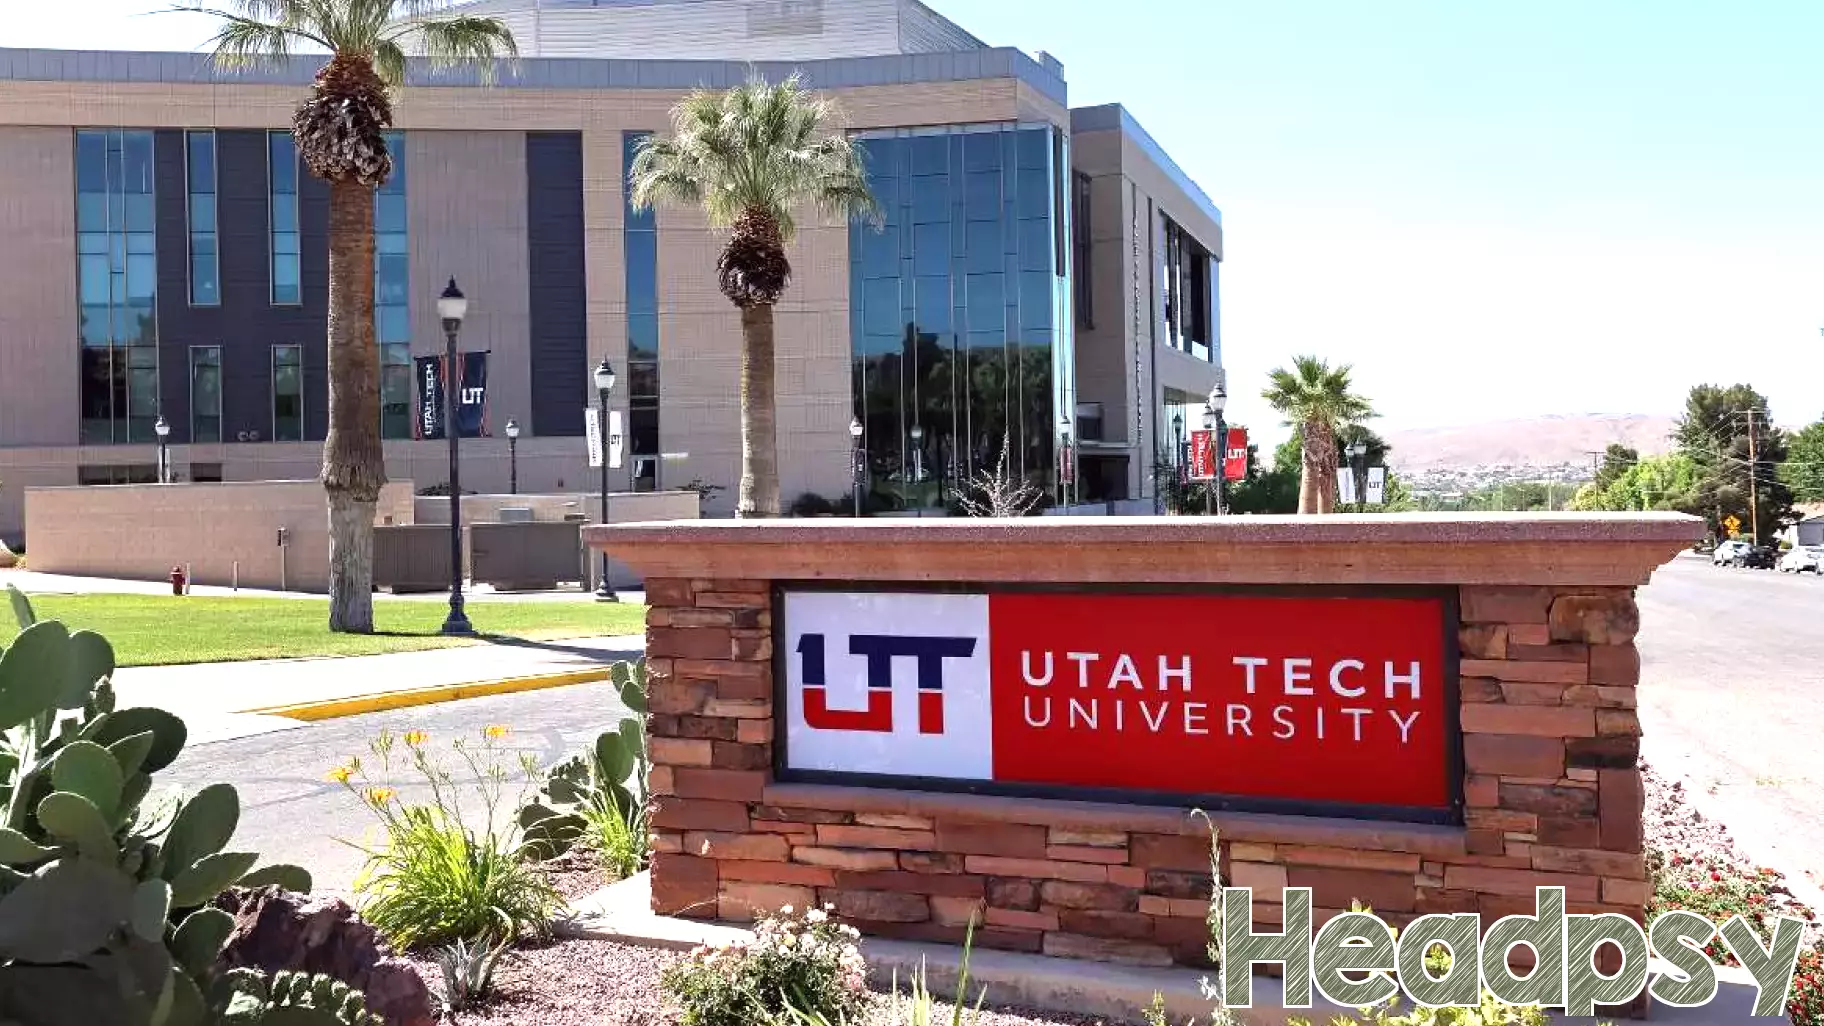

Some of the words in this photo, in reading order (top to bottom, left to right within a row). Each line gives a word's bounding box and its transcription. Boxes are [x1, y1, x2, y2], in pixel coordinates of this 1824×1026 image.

[1022, 650, 1193, 694] UTAH
[1233, 656, 1421, 700] TECH
[1023, 696, 1422, 744] UNIVERSITY
